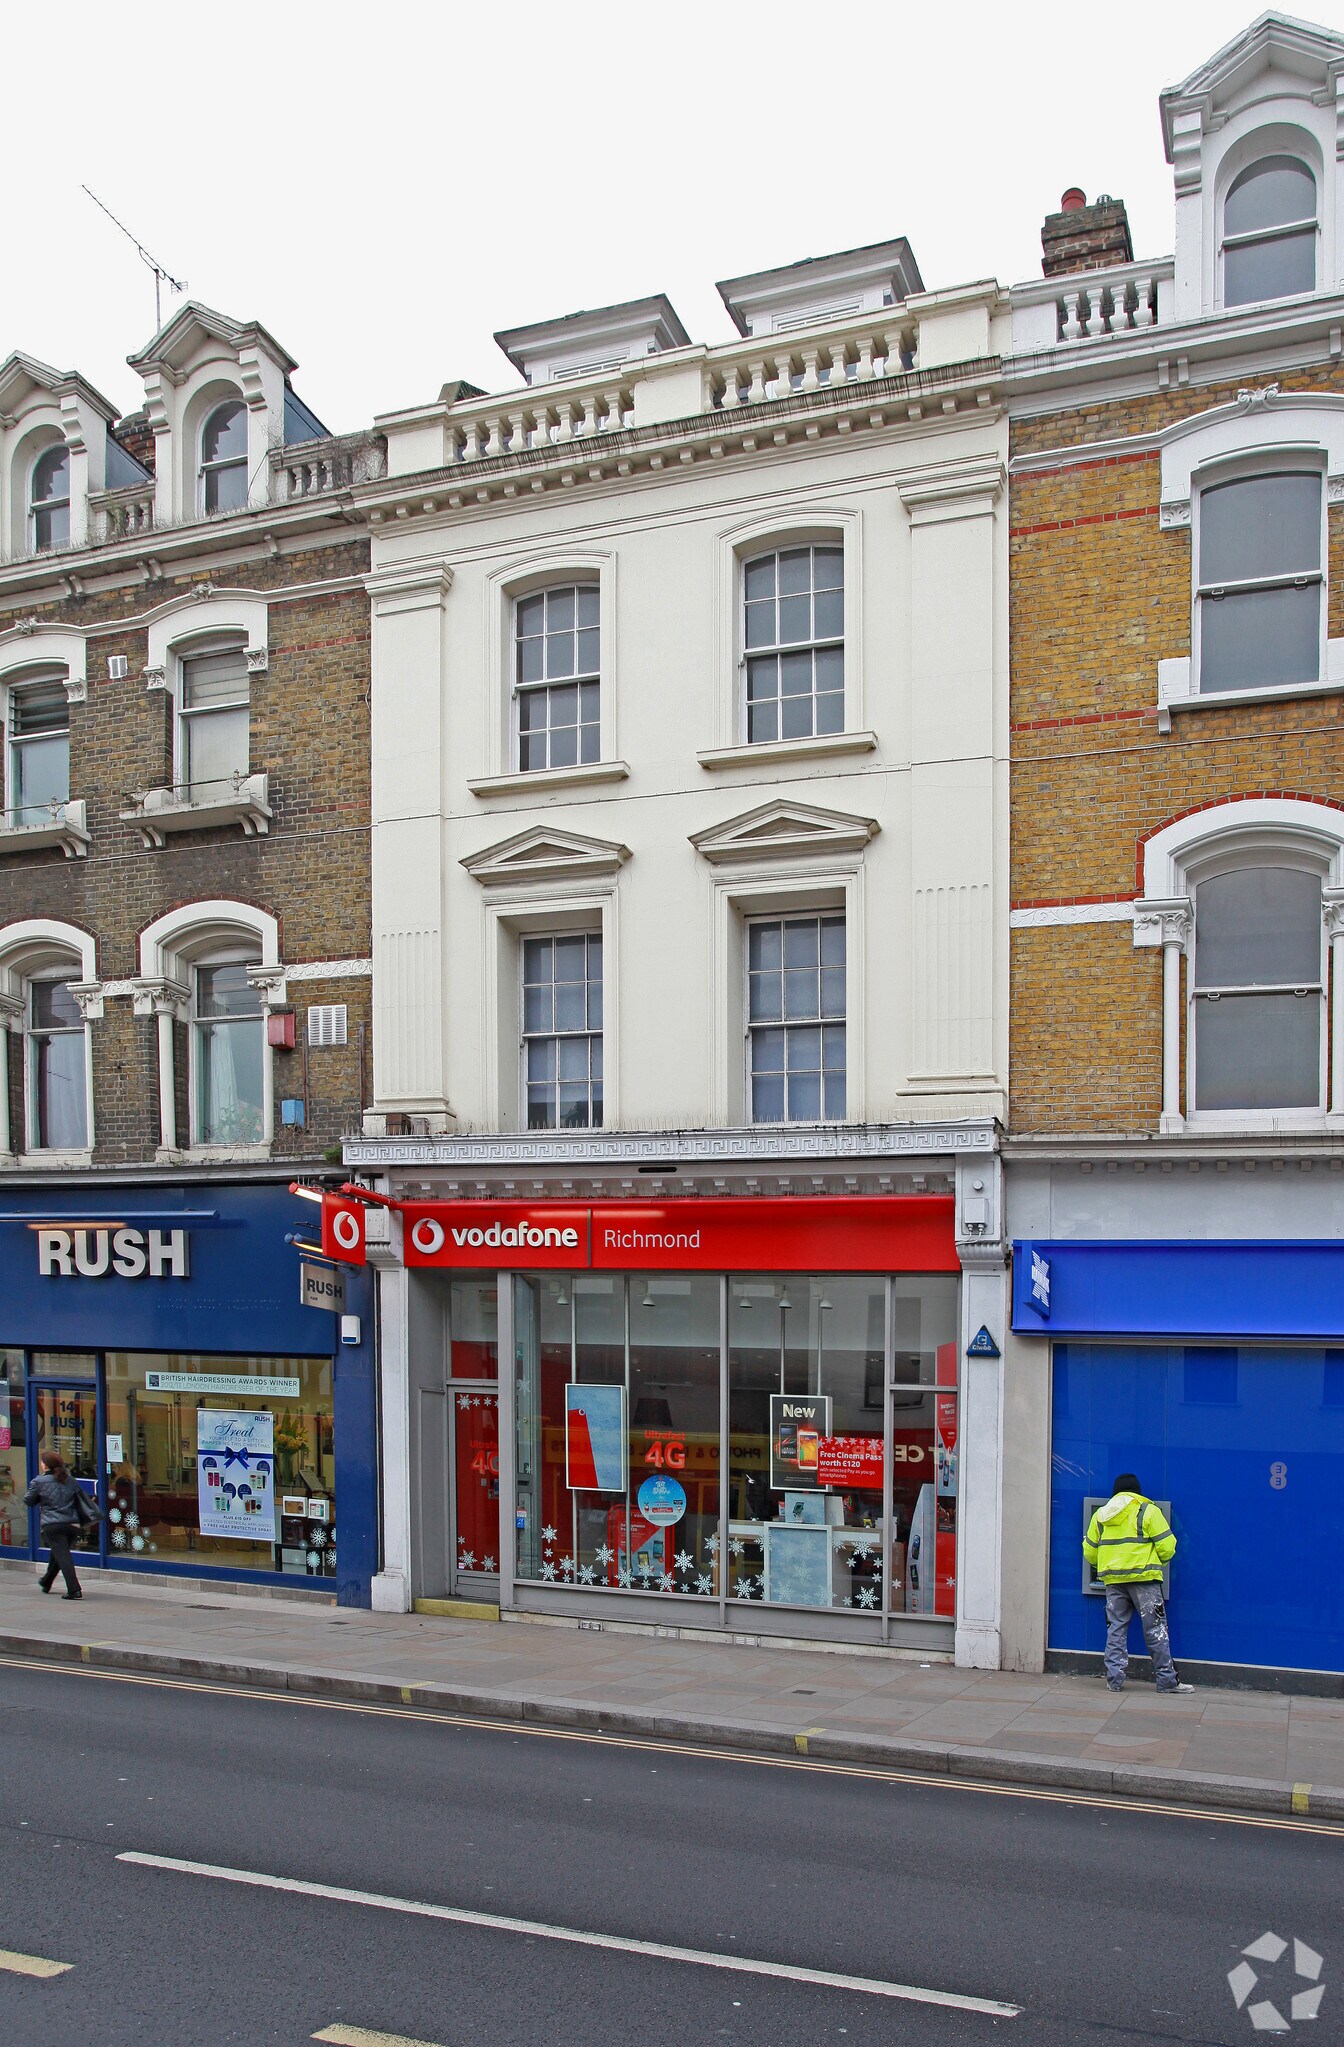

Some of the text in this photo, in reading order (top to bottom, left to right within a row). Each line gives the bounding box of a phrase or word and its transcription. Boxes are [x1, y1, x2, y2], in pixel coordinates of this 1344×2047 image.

[452, 1221, 578, 1247] vodafone
[604, 1229, 700, 1248] Richmond
[39, 1228, 188, 1277] RUSH
[306, 1278, 343, 1298] RUSH
[161, 1374, 186, 1382] BRITISH
[188, 1376, 237, 1384] HAIRDRESSING
[239, 1378, 267, 1386] AWARDS
[269, 1379, 298, 1387] WINNER
[183, 1382, 210, 1390] LONDON
[211, 1383, 254, 1392] HAIRDRESSER
[60, 1401, 74, 1412] 14
[782, 1403, 816, 1418] New
[50, 1416, 85, 1429] RUSH
[214, 1419, 255, 1437] Treat
[644, 1429, 686, 1441] Ultrafast
[469, 1439, 498, 1449] Ultrafa
[644, 1441, 686, 1469] 4G
[820, 1450, 883, 1461] Free Cinema Pass
[842, 1460, 861, 1468] £120
[820, 1472, 847, 1480] smartphones
